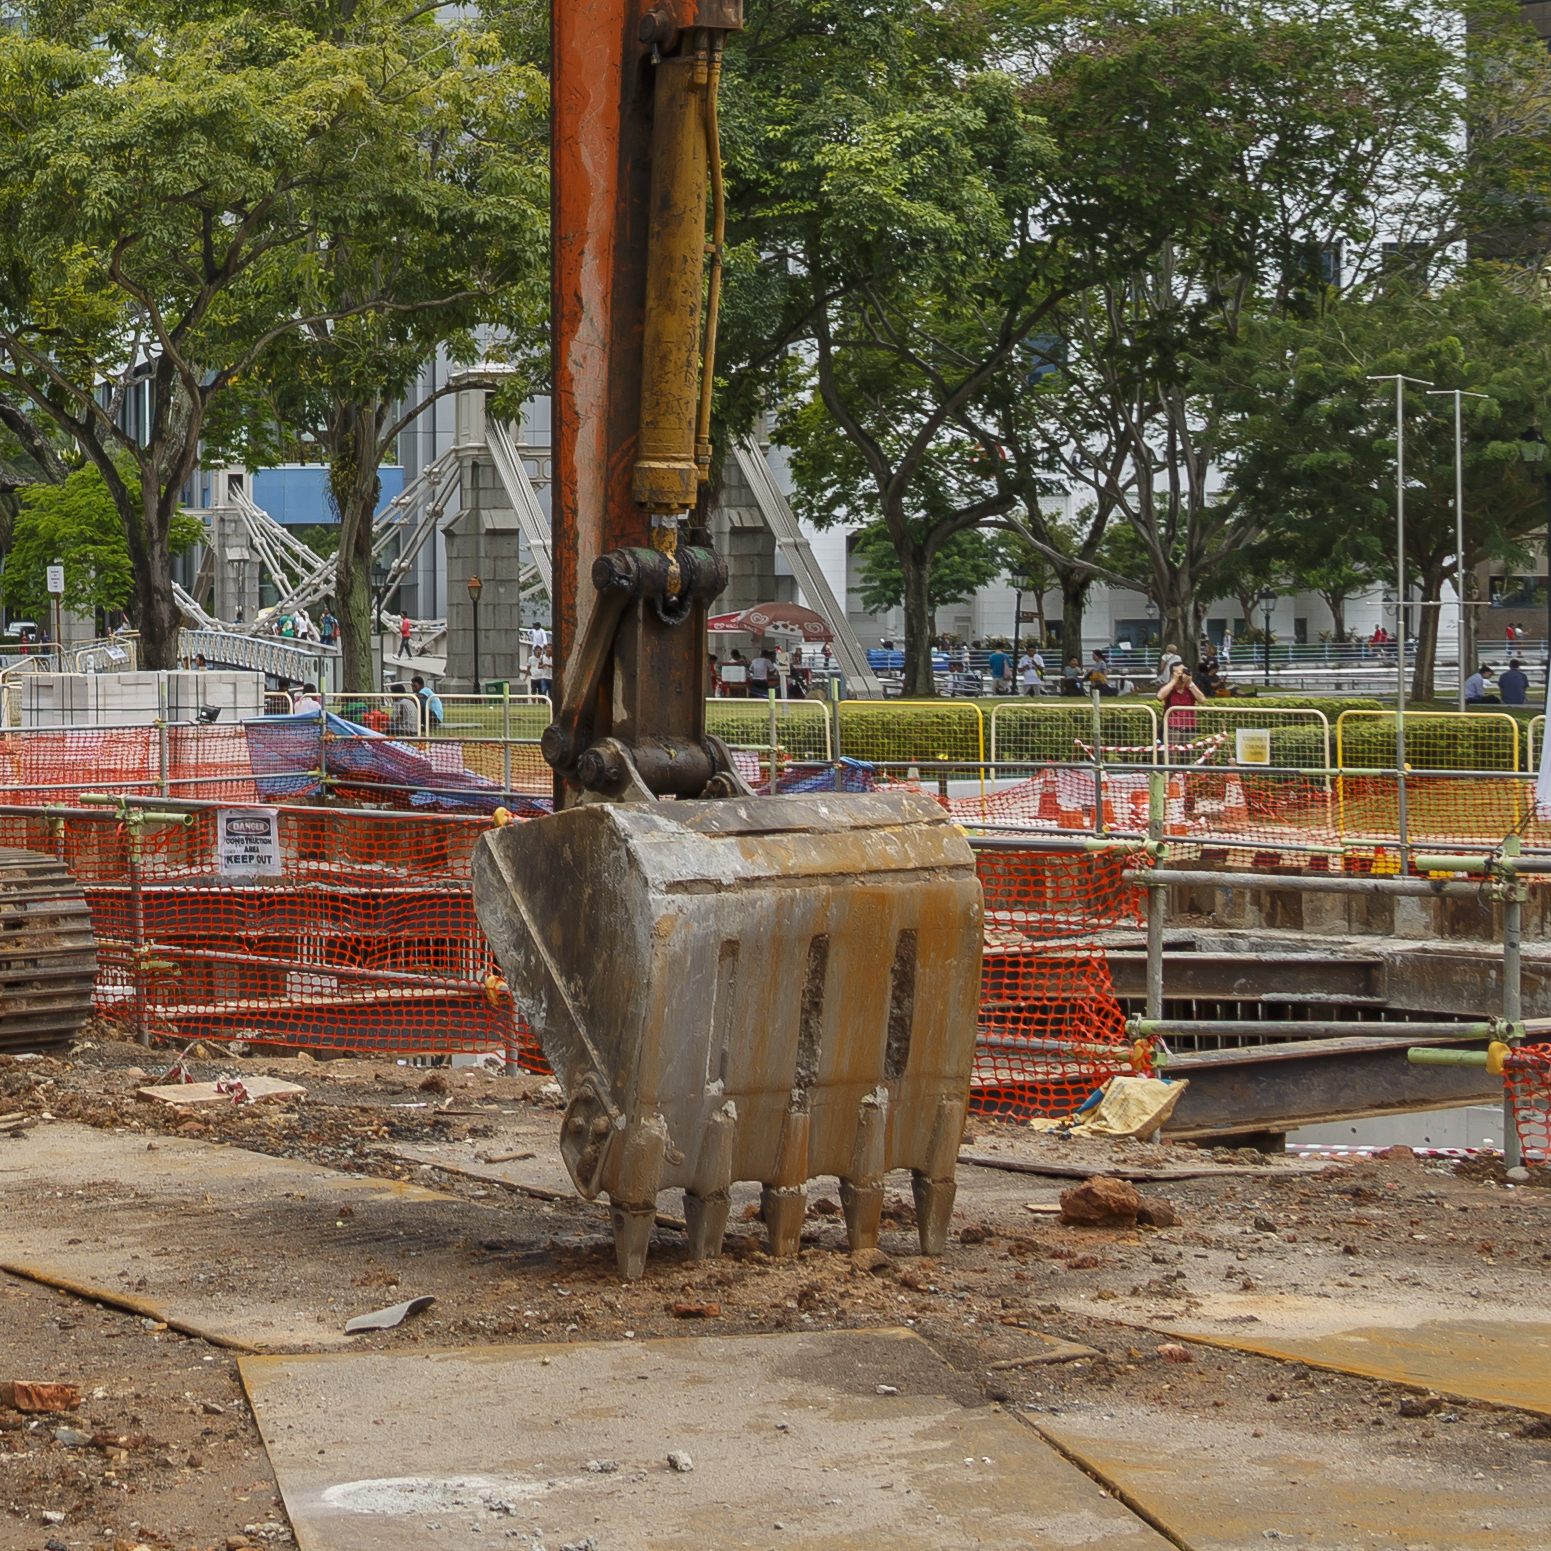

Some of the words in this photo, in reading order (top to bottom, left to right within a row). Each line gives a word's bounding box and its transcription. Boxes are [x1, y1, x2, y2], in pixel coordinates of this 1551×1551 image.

[232, 822, 265, 831] DANGER
[226, 854, 255, 864] KEEP
[256, 855, 272, 865] OUT
